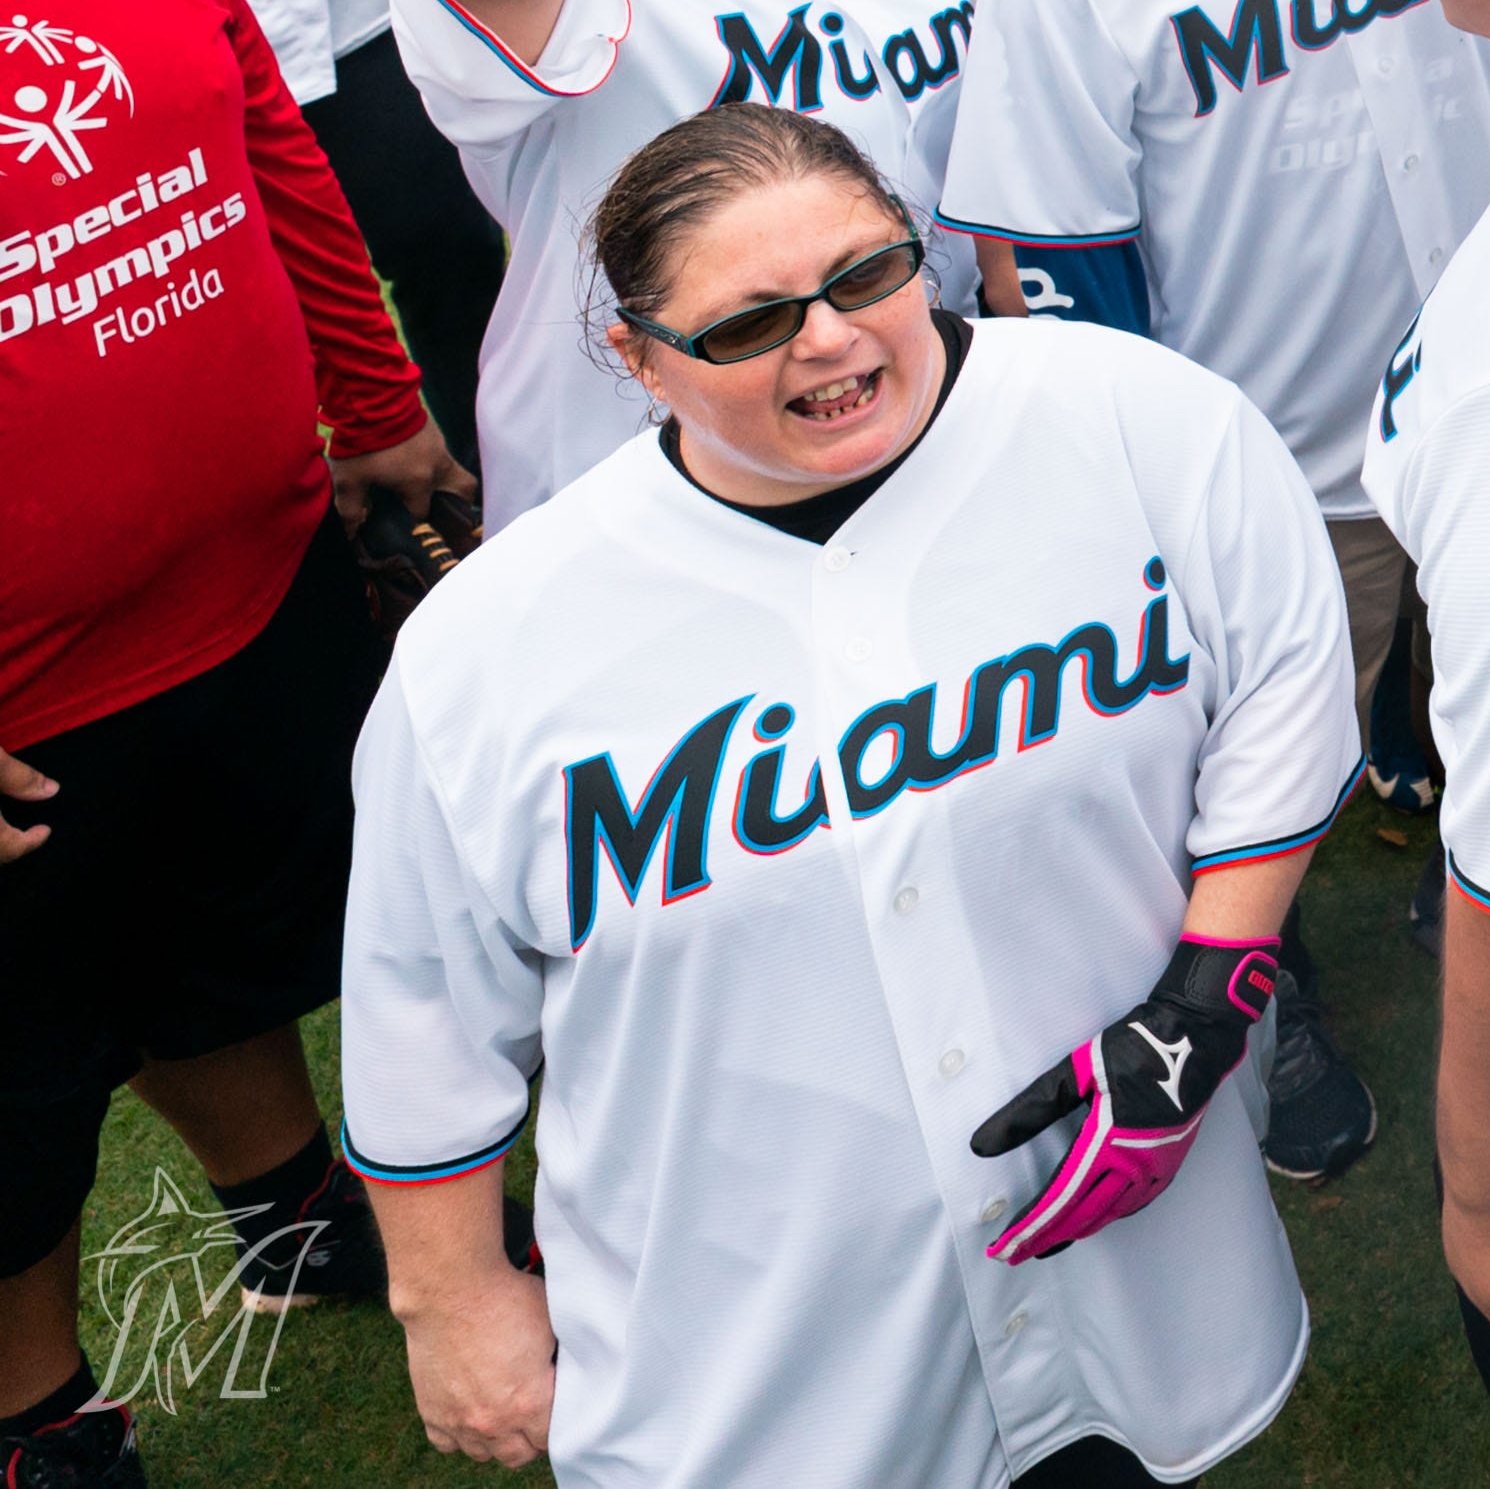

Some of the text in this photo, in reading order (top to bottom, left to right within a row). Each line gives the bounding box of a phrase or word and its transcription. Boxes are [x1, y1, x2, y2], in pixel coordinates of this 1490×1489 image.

[0, 146, 208, 283] Special
[0, 192, 246, 343] Olympics
[93, 268, 225, 358] Florida
[562, 555, 1193, 955] Miami
